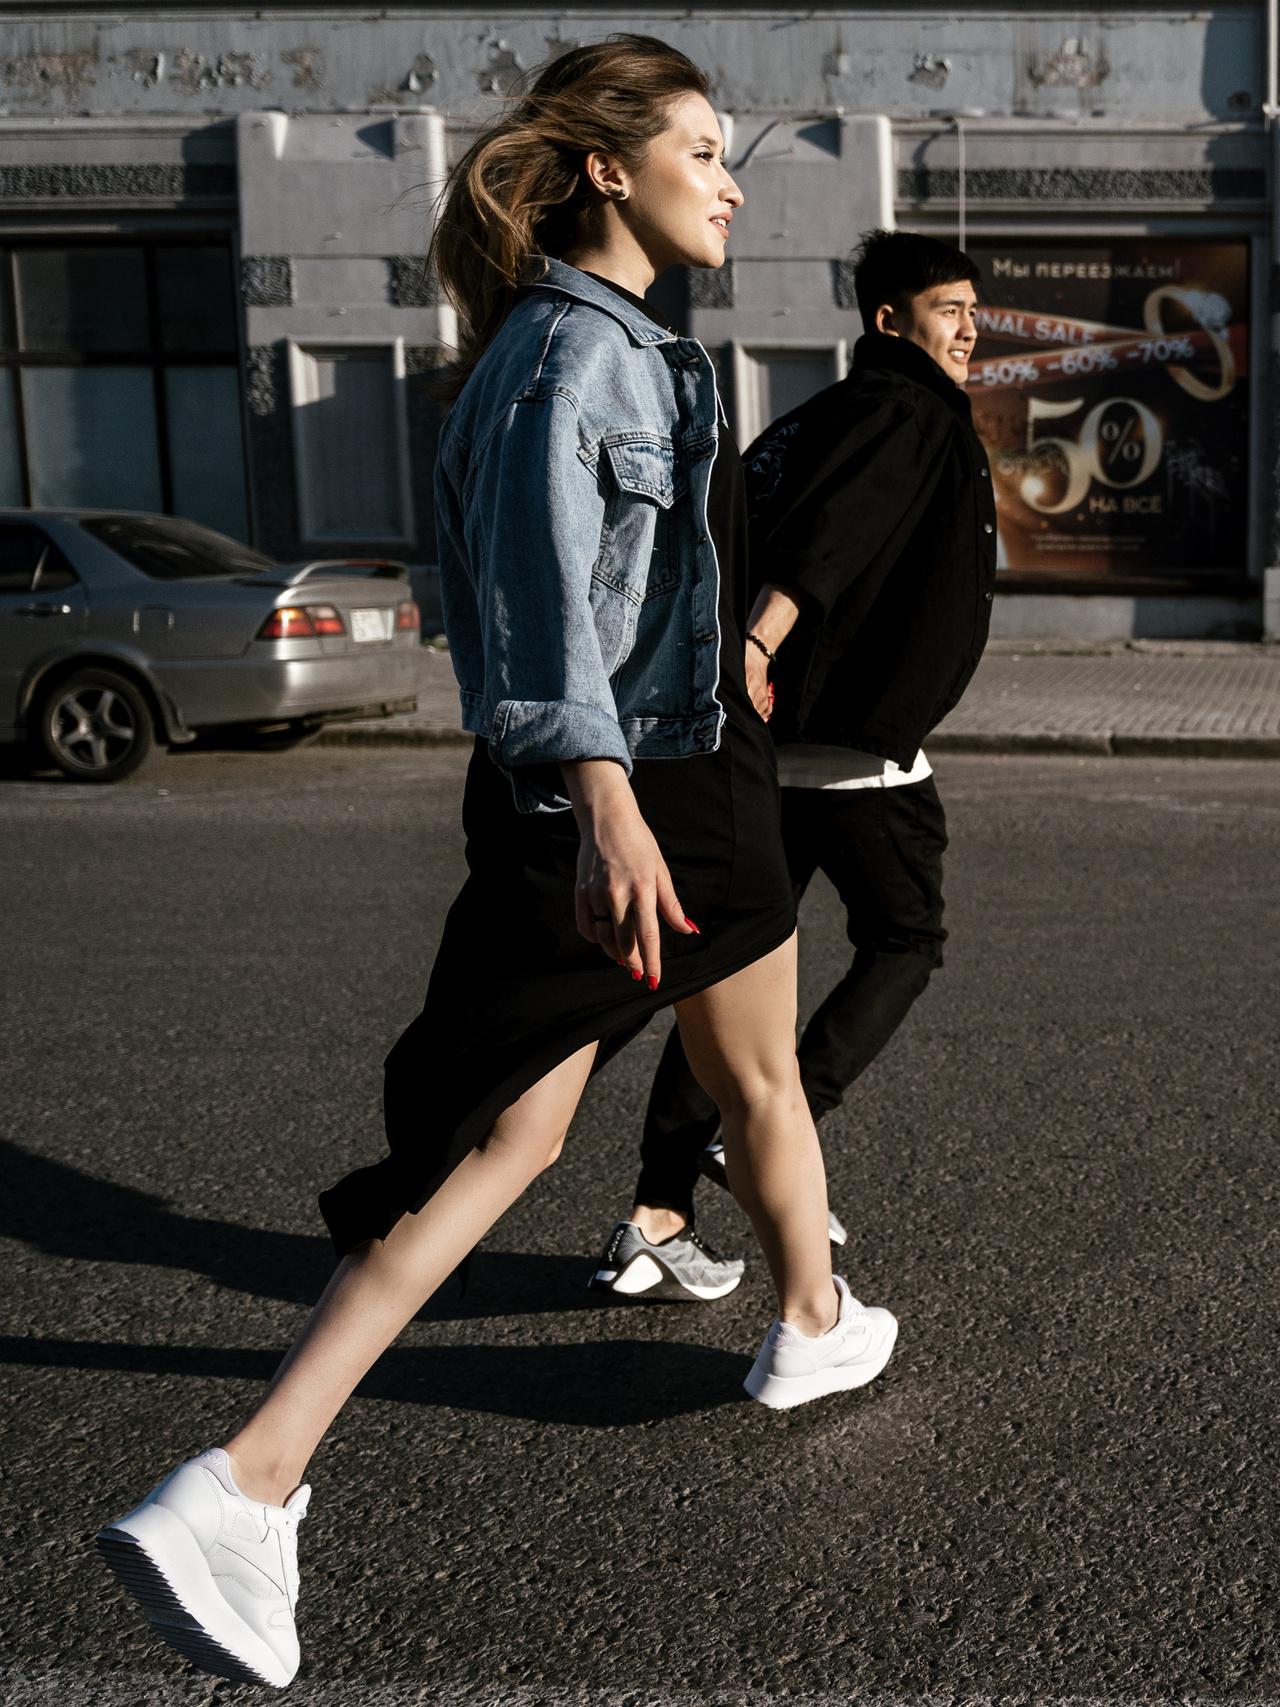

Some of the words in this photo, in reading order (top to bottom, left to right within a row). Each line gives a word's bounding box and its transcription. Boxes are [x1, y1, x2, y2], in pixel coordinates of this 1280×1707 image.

[974, 309, 1030, 338] INAL
[1033, 320, 1096, 347] SALE
[968, 360, 1040, 387] -50%
[1046, 346, 1119, 376] -60%
[1126, 336, 1196, 363] -70%
